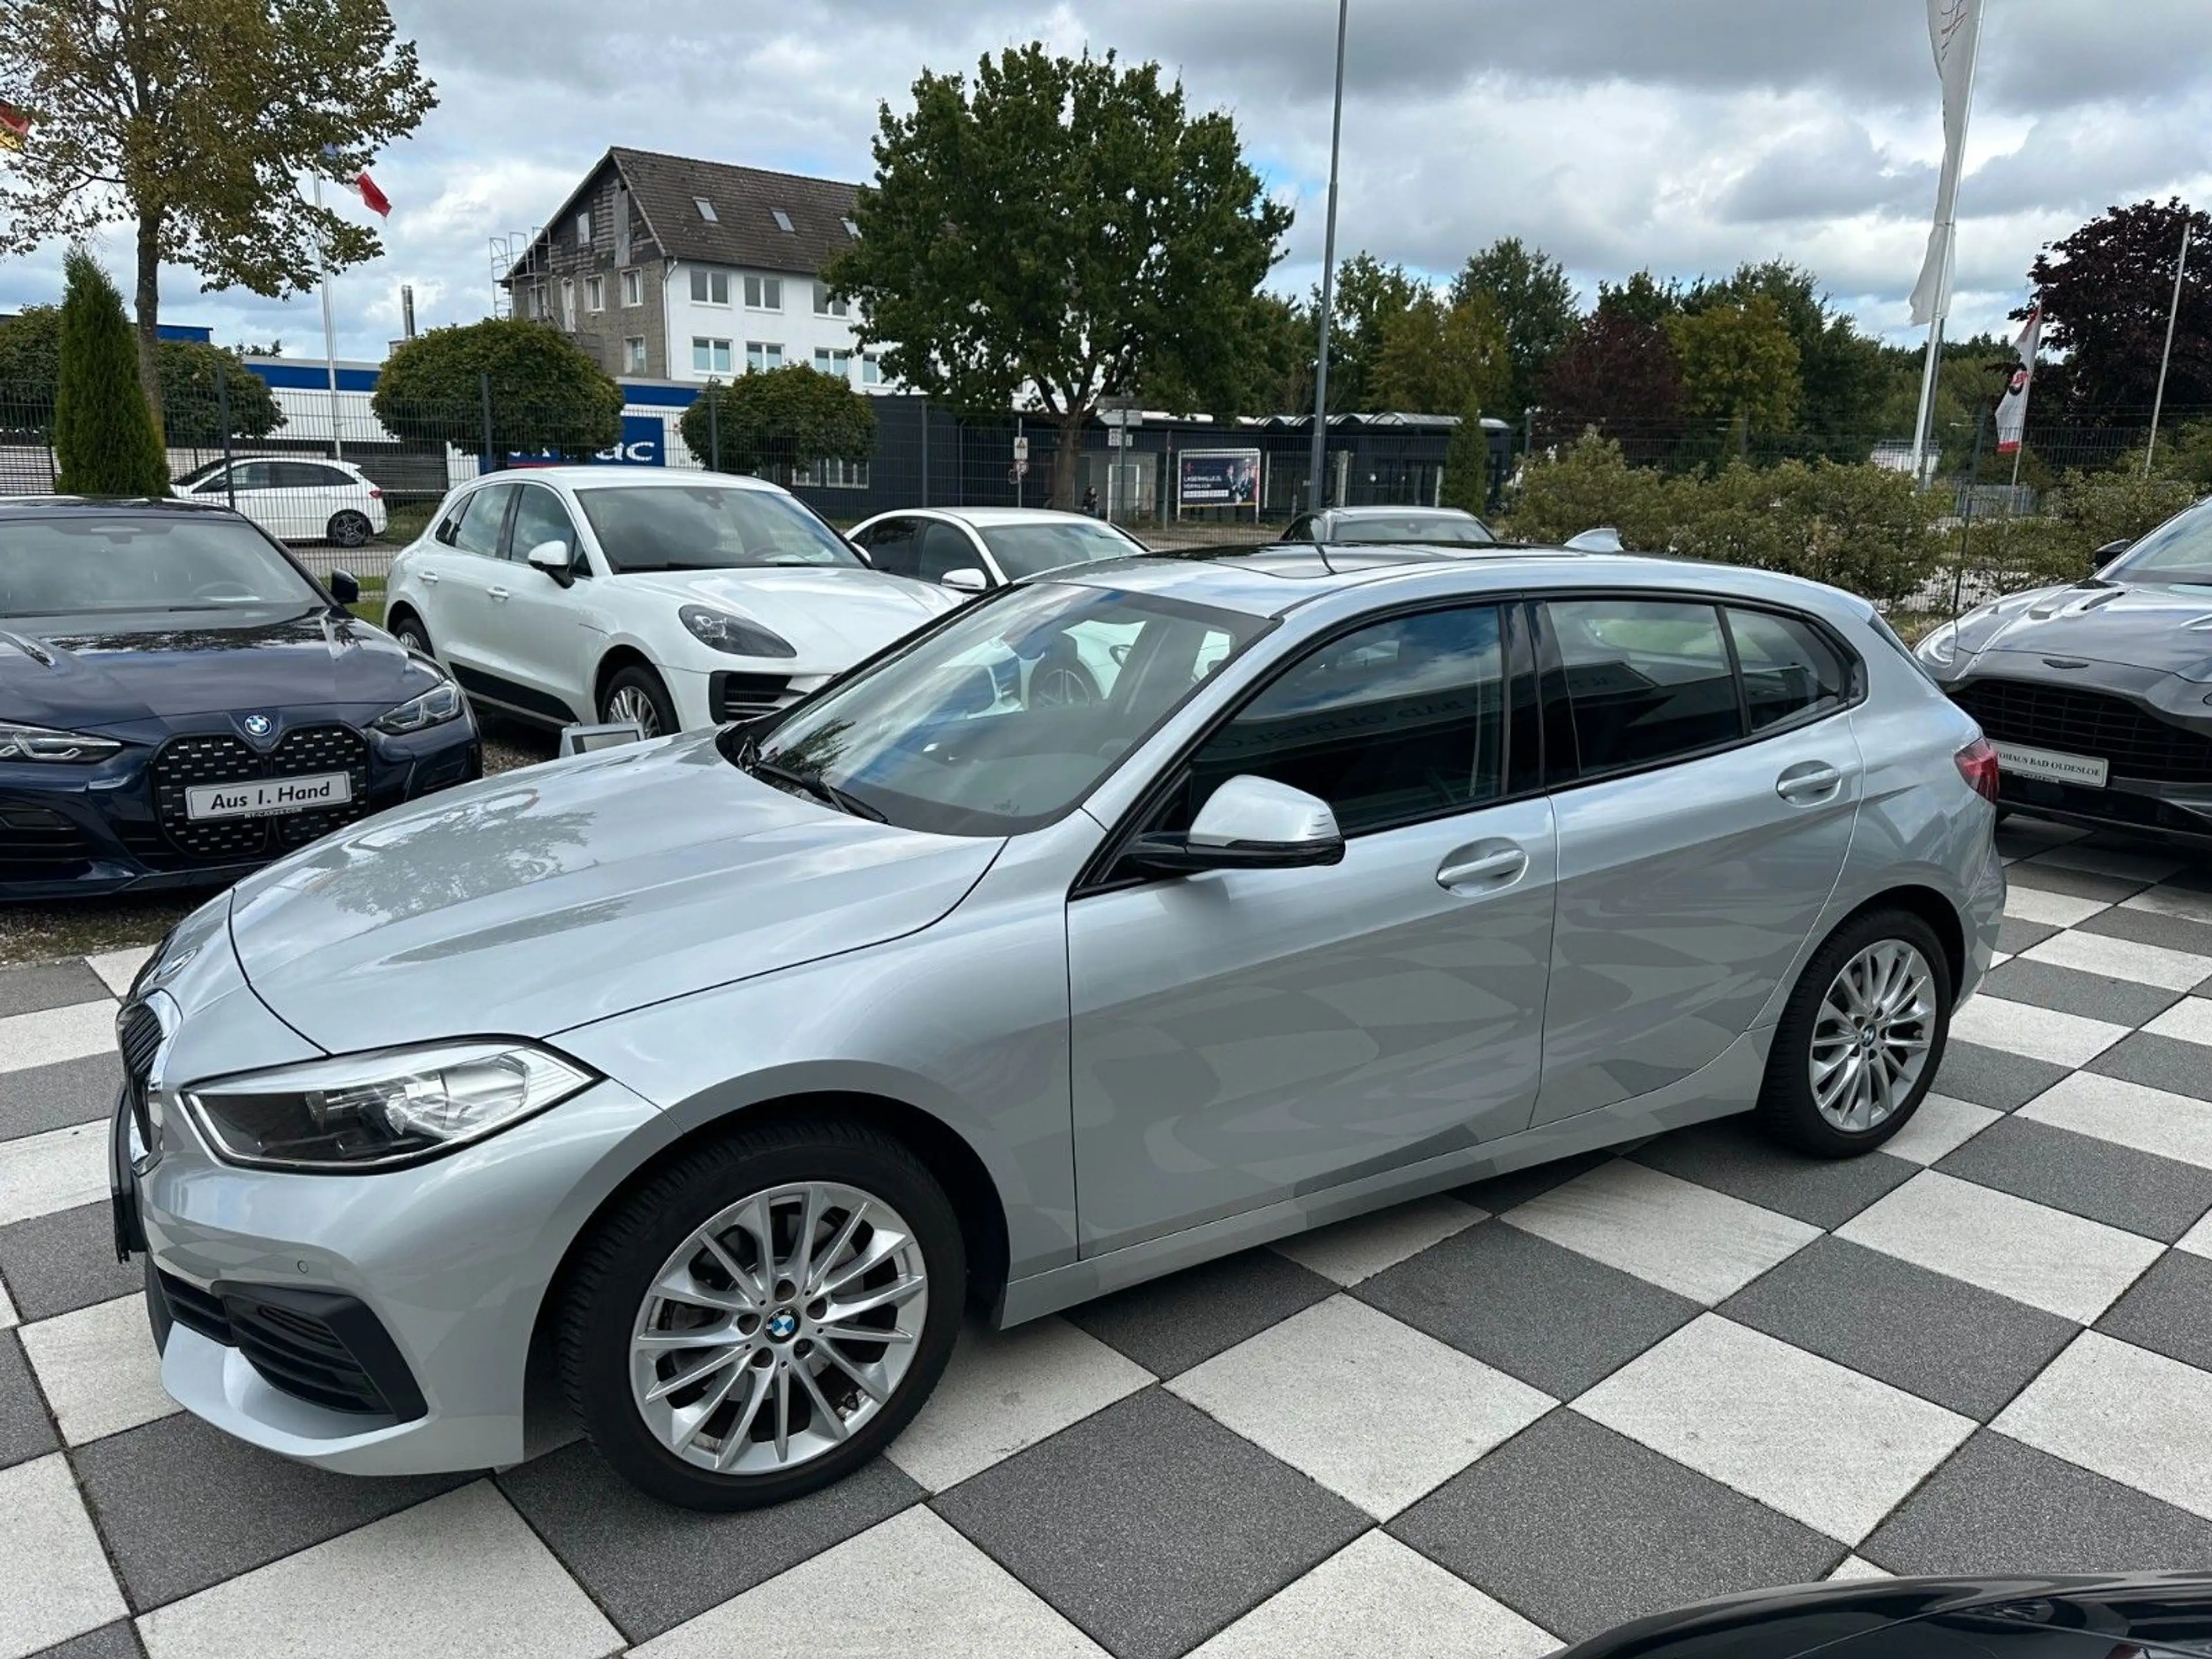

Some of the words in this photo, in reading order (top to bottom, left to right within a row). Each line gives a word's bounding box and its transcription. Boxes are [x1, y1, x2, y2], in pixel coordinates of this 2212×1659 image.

[2029, 757, 2049, 768] BAD
[211, 794, 247, 809] Aus
[278, 781, 330, 802] Hand
